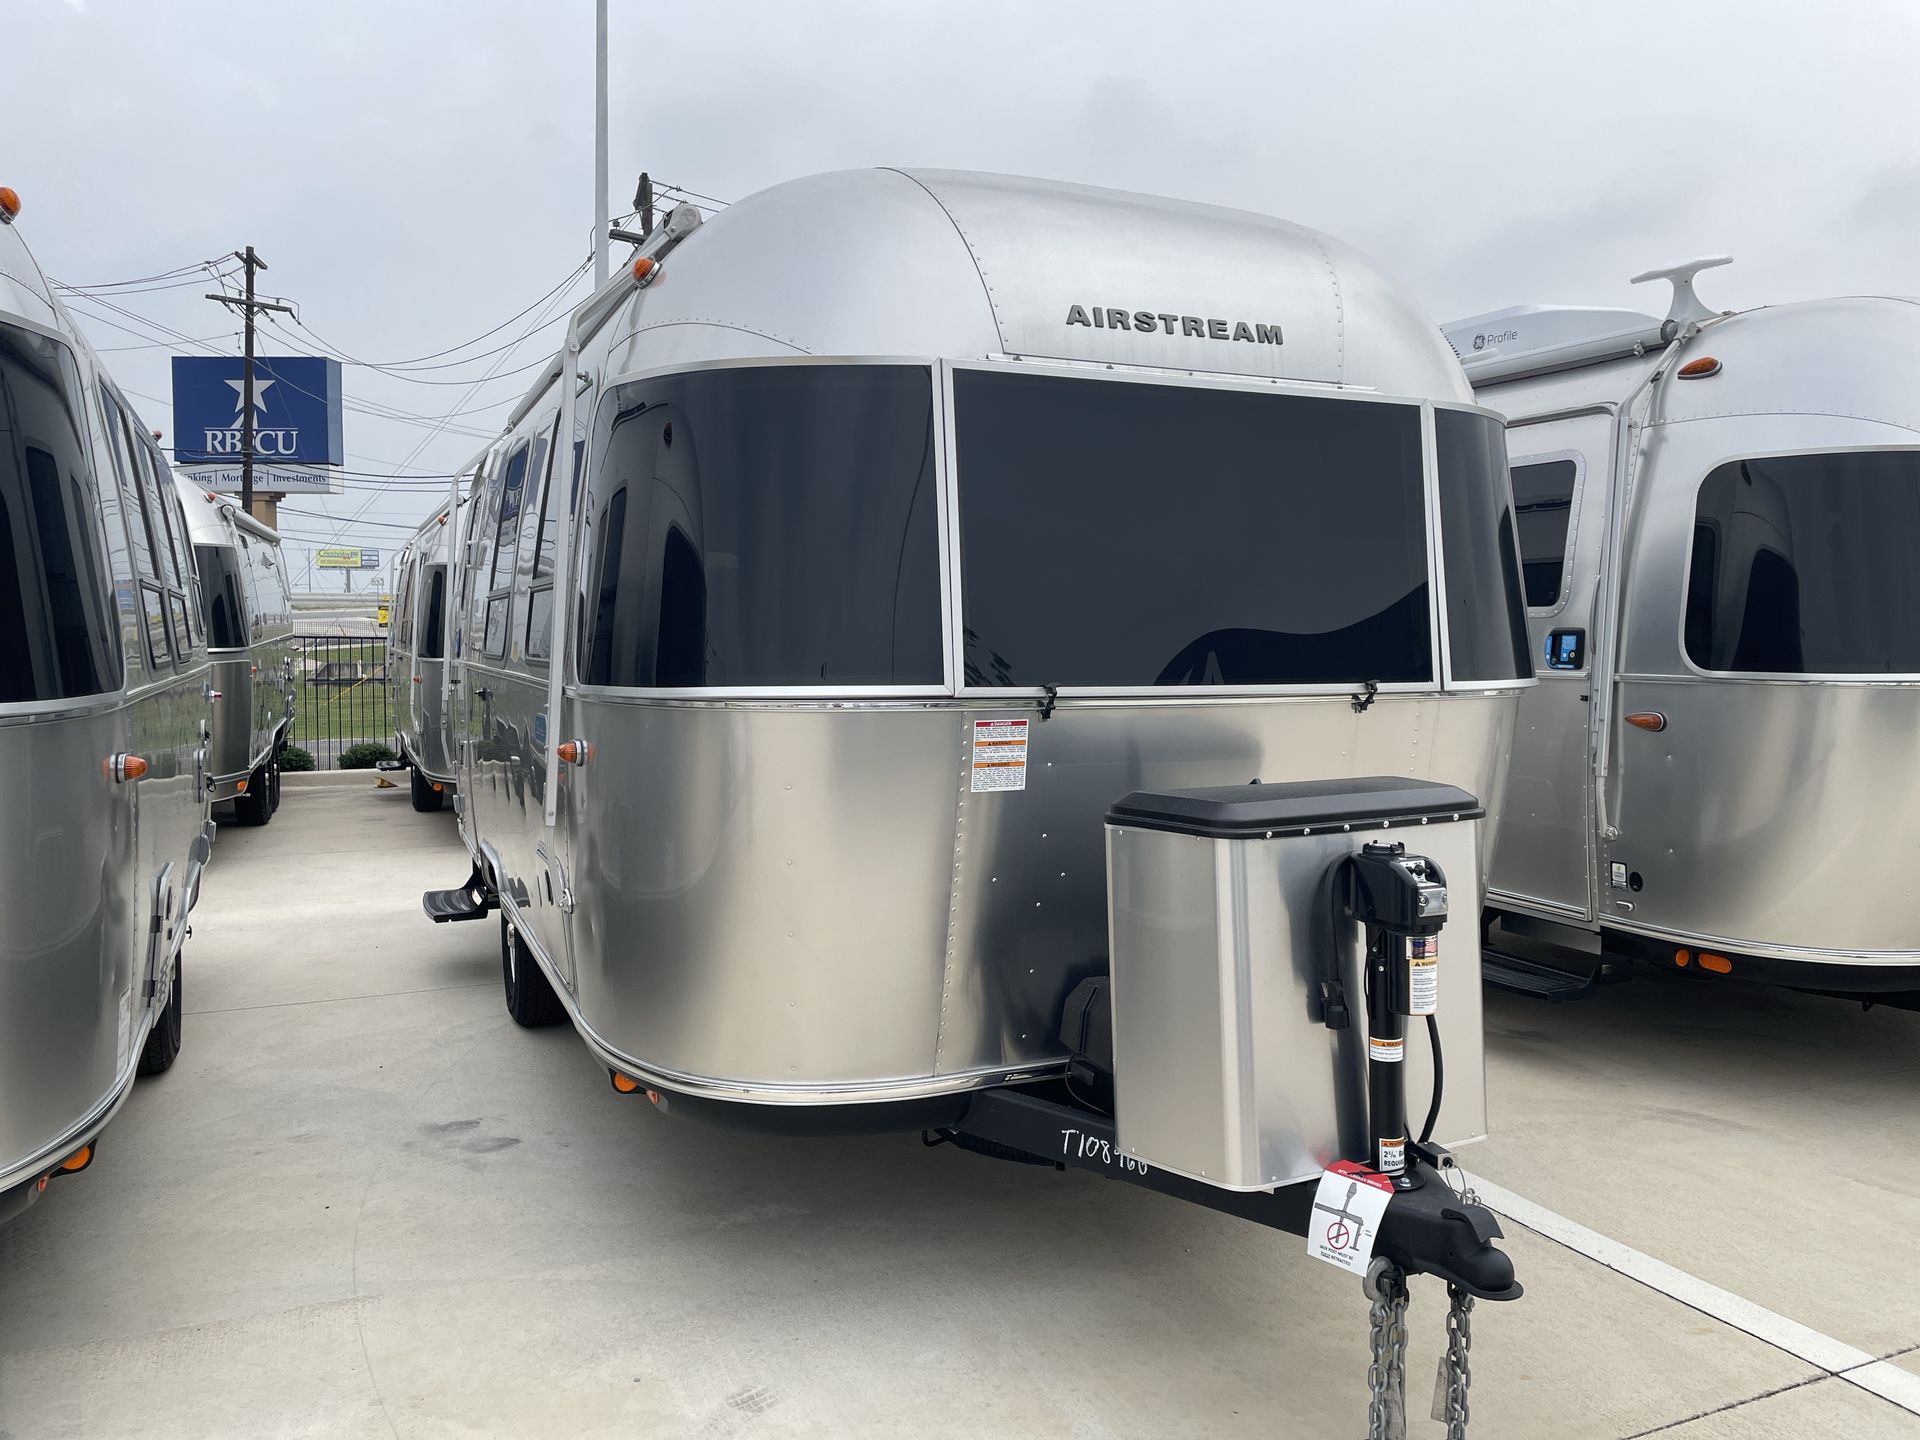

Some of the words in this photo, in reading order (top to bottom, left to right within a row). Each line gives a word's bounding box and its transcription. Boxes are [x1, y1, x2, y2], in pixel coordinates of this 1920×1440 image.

[1066, 304, 1284, 345] AIRSTREAM
[1487, 330, 1518, 345] Profile
[204, 430, 298, 455] RBCU
[221, 473, 264, 485] Mortge
[273, 473, 326, 483] Investments
